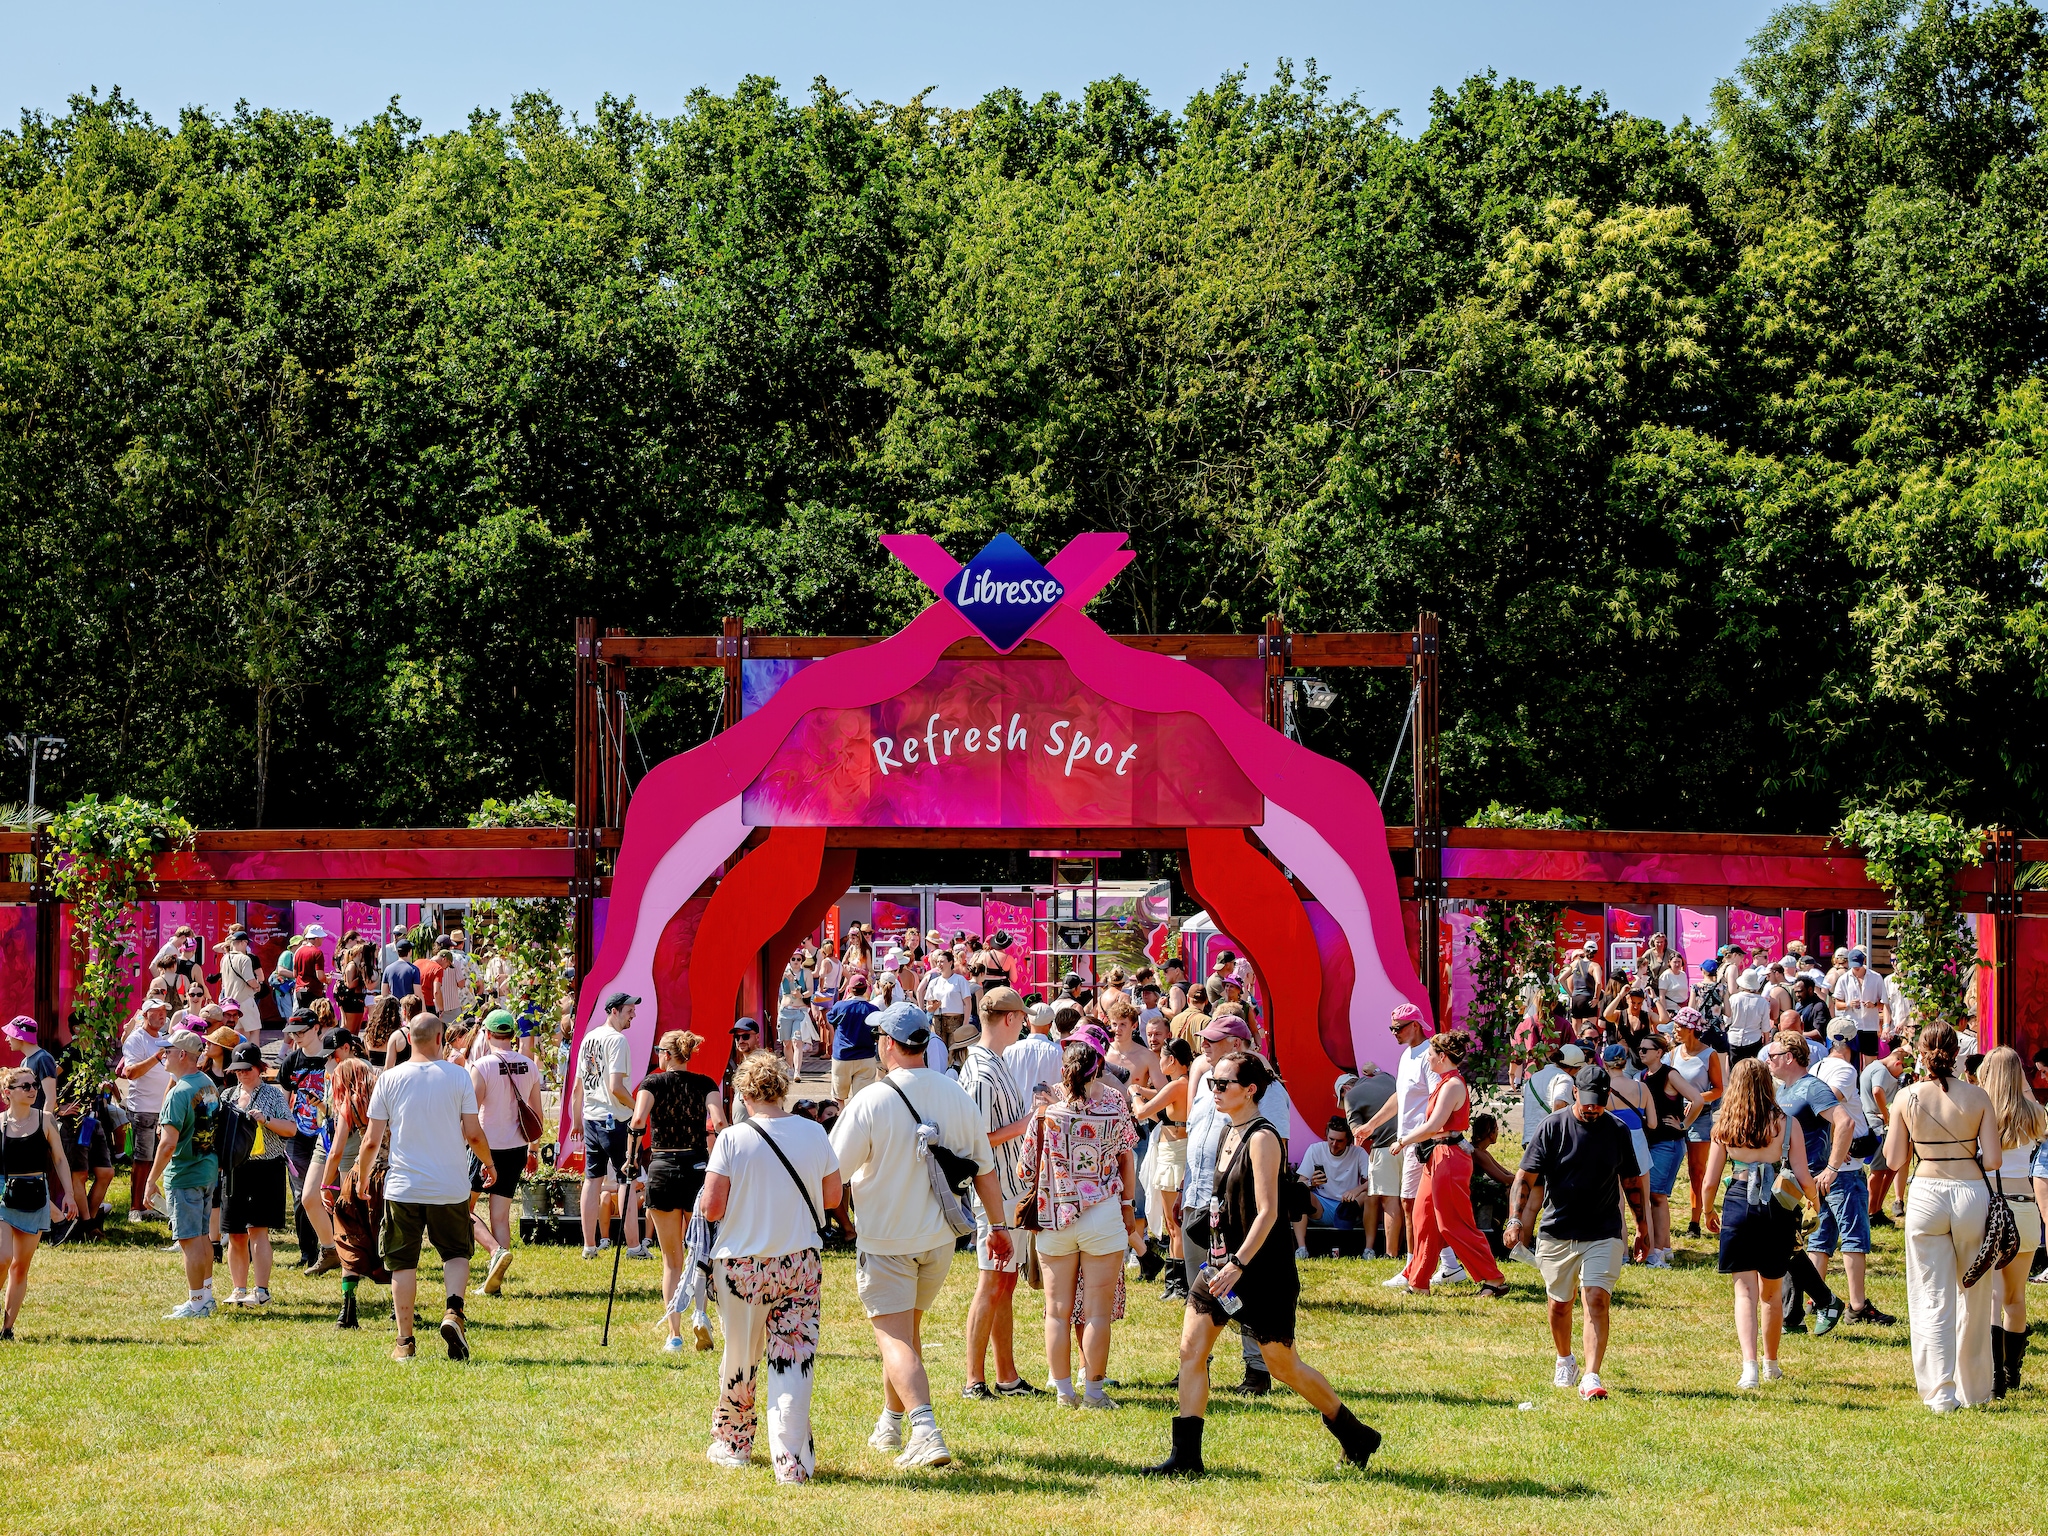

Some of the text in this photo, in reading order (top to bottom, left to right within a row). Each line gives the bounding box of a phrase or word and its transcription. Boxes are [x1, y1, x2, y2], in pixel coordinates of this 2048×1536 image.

[957, 568, 1060, 606] Libresse
[871, 713, 1138, 777] Refresh Spot
